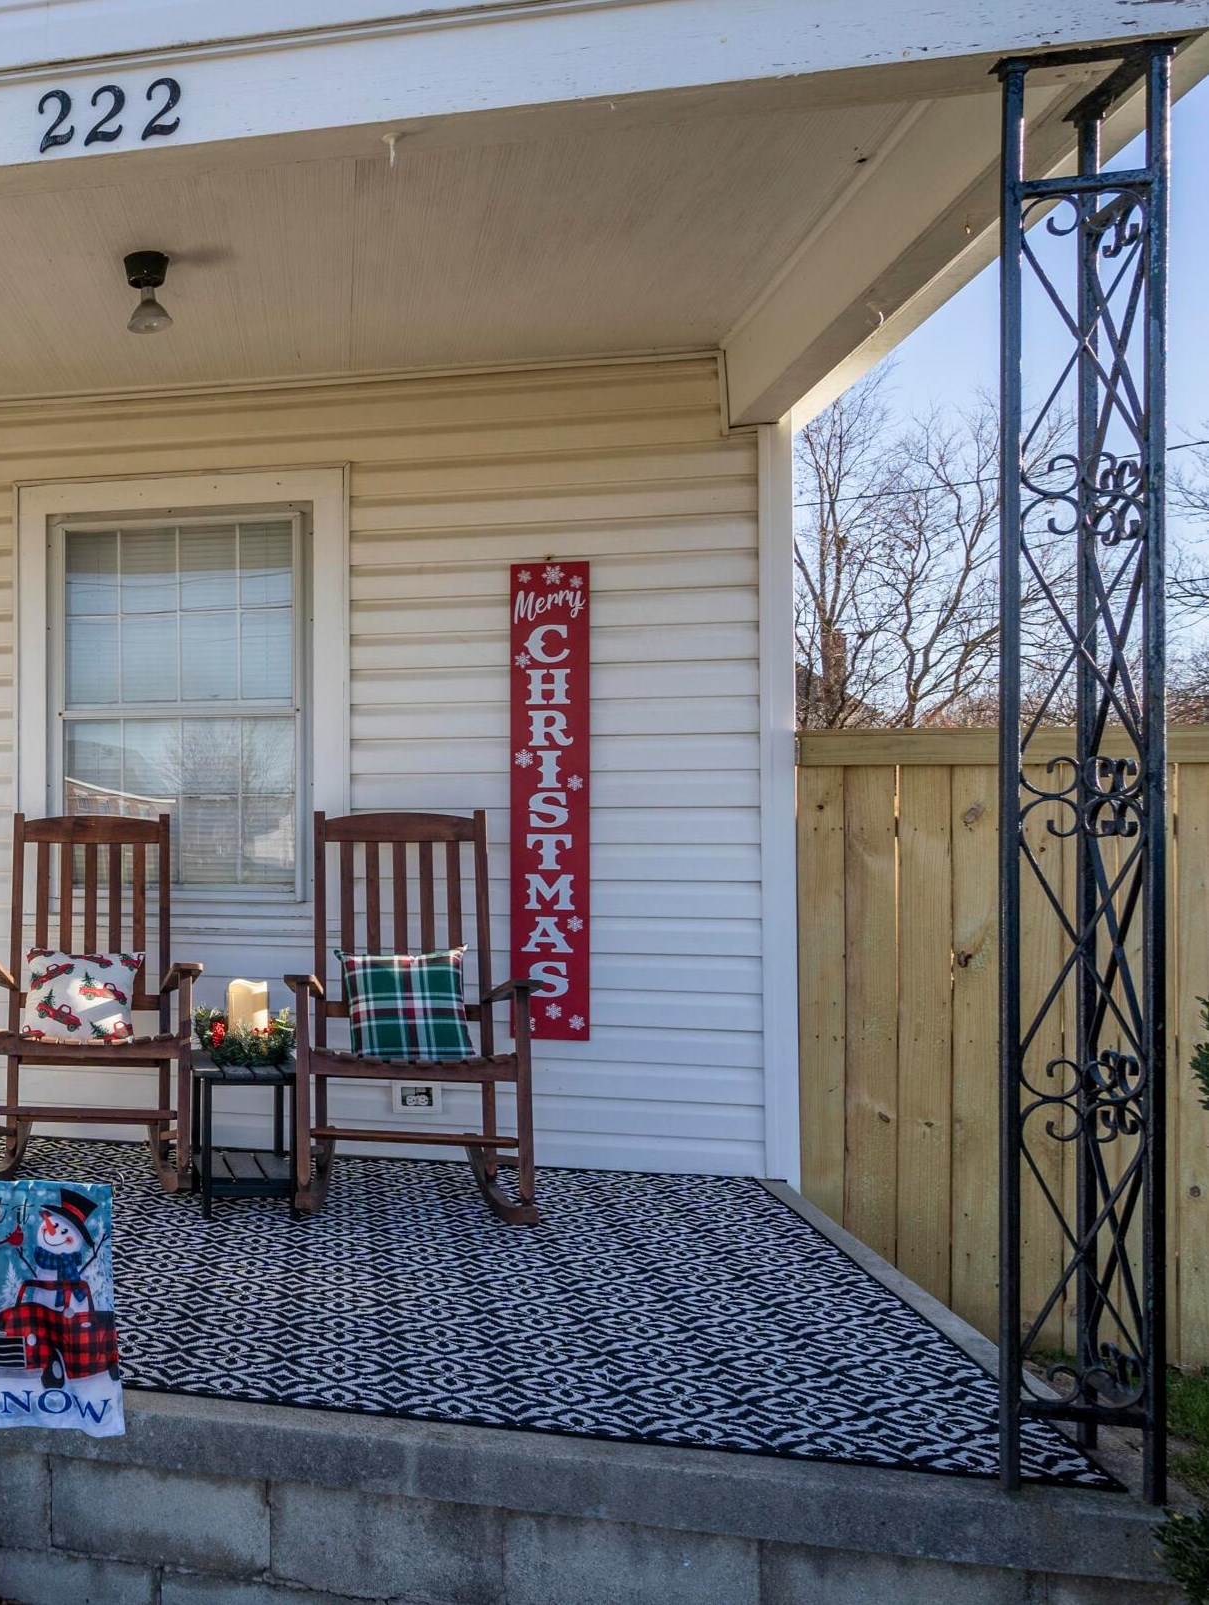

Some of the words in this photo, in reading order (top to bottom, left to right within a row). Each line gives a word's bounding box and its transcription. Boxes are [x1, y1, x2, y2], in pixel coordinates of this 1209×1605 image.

[38, 77, 181, 153] 222
[513, 589, 586, 624] Merry
[521, 624, 575, 998] CHRISTMAS
[11, 1197, 34, 1225] it
